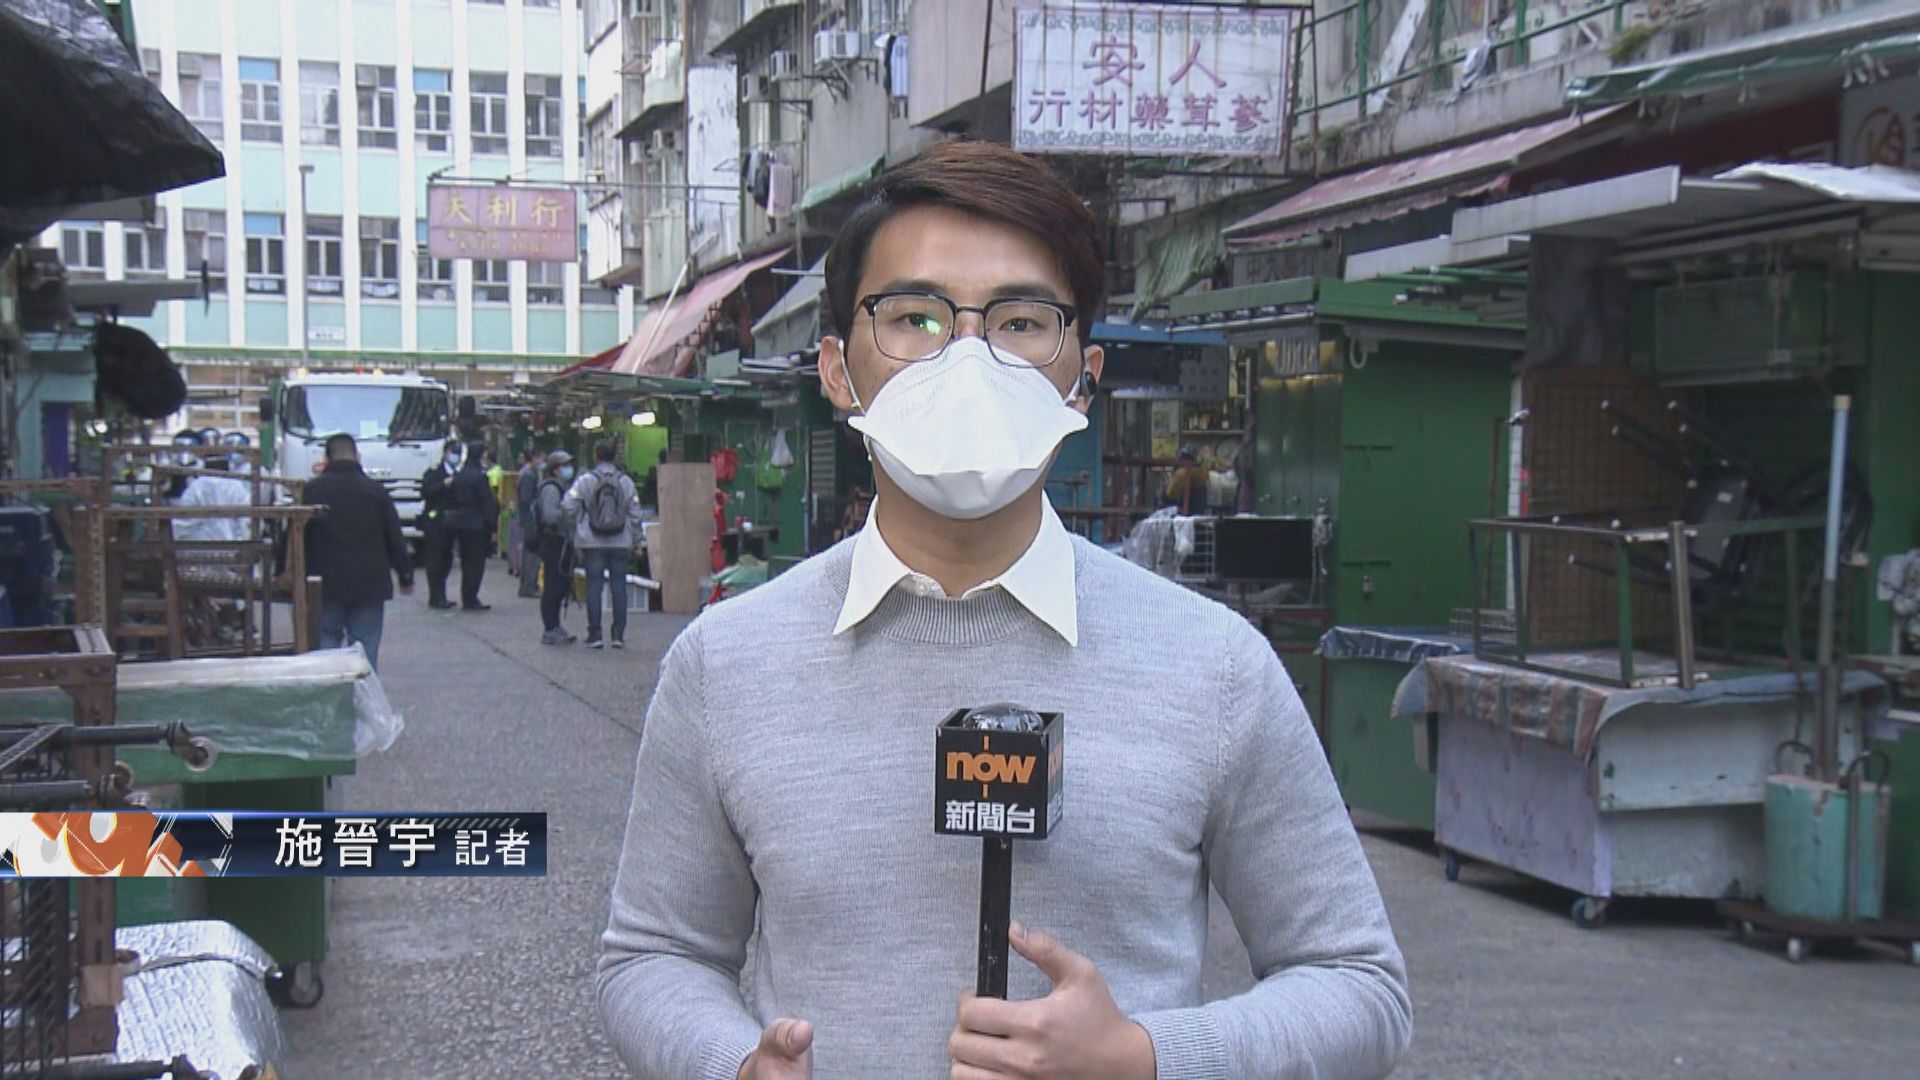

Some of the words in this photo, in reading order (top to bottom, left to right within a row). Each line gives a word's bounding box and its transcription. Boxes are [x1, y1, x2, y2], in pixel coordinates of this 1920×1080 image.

[946, 751, 1036, 784] now
[945, 801, 1035, 833] 新聞台
